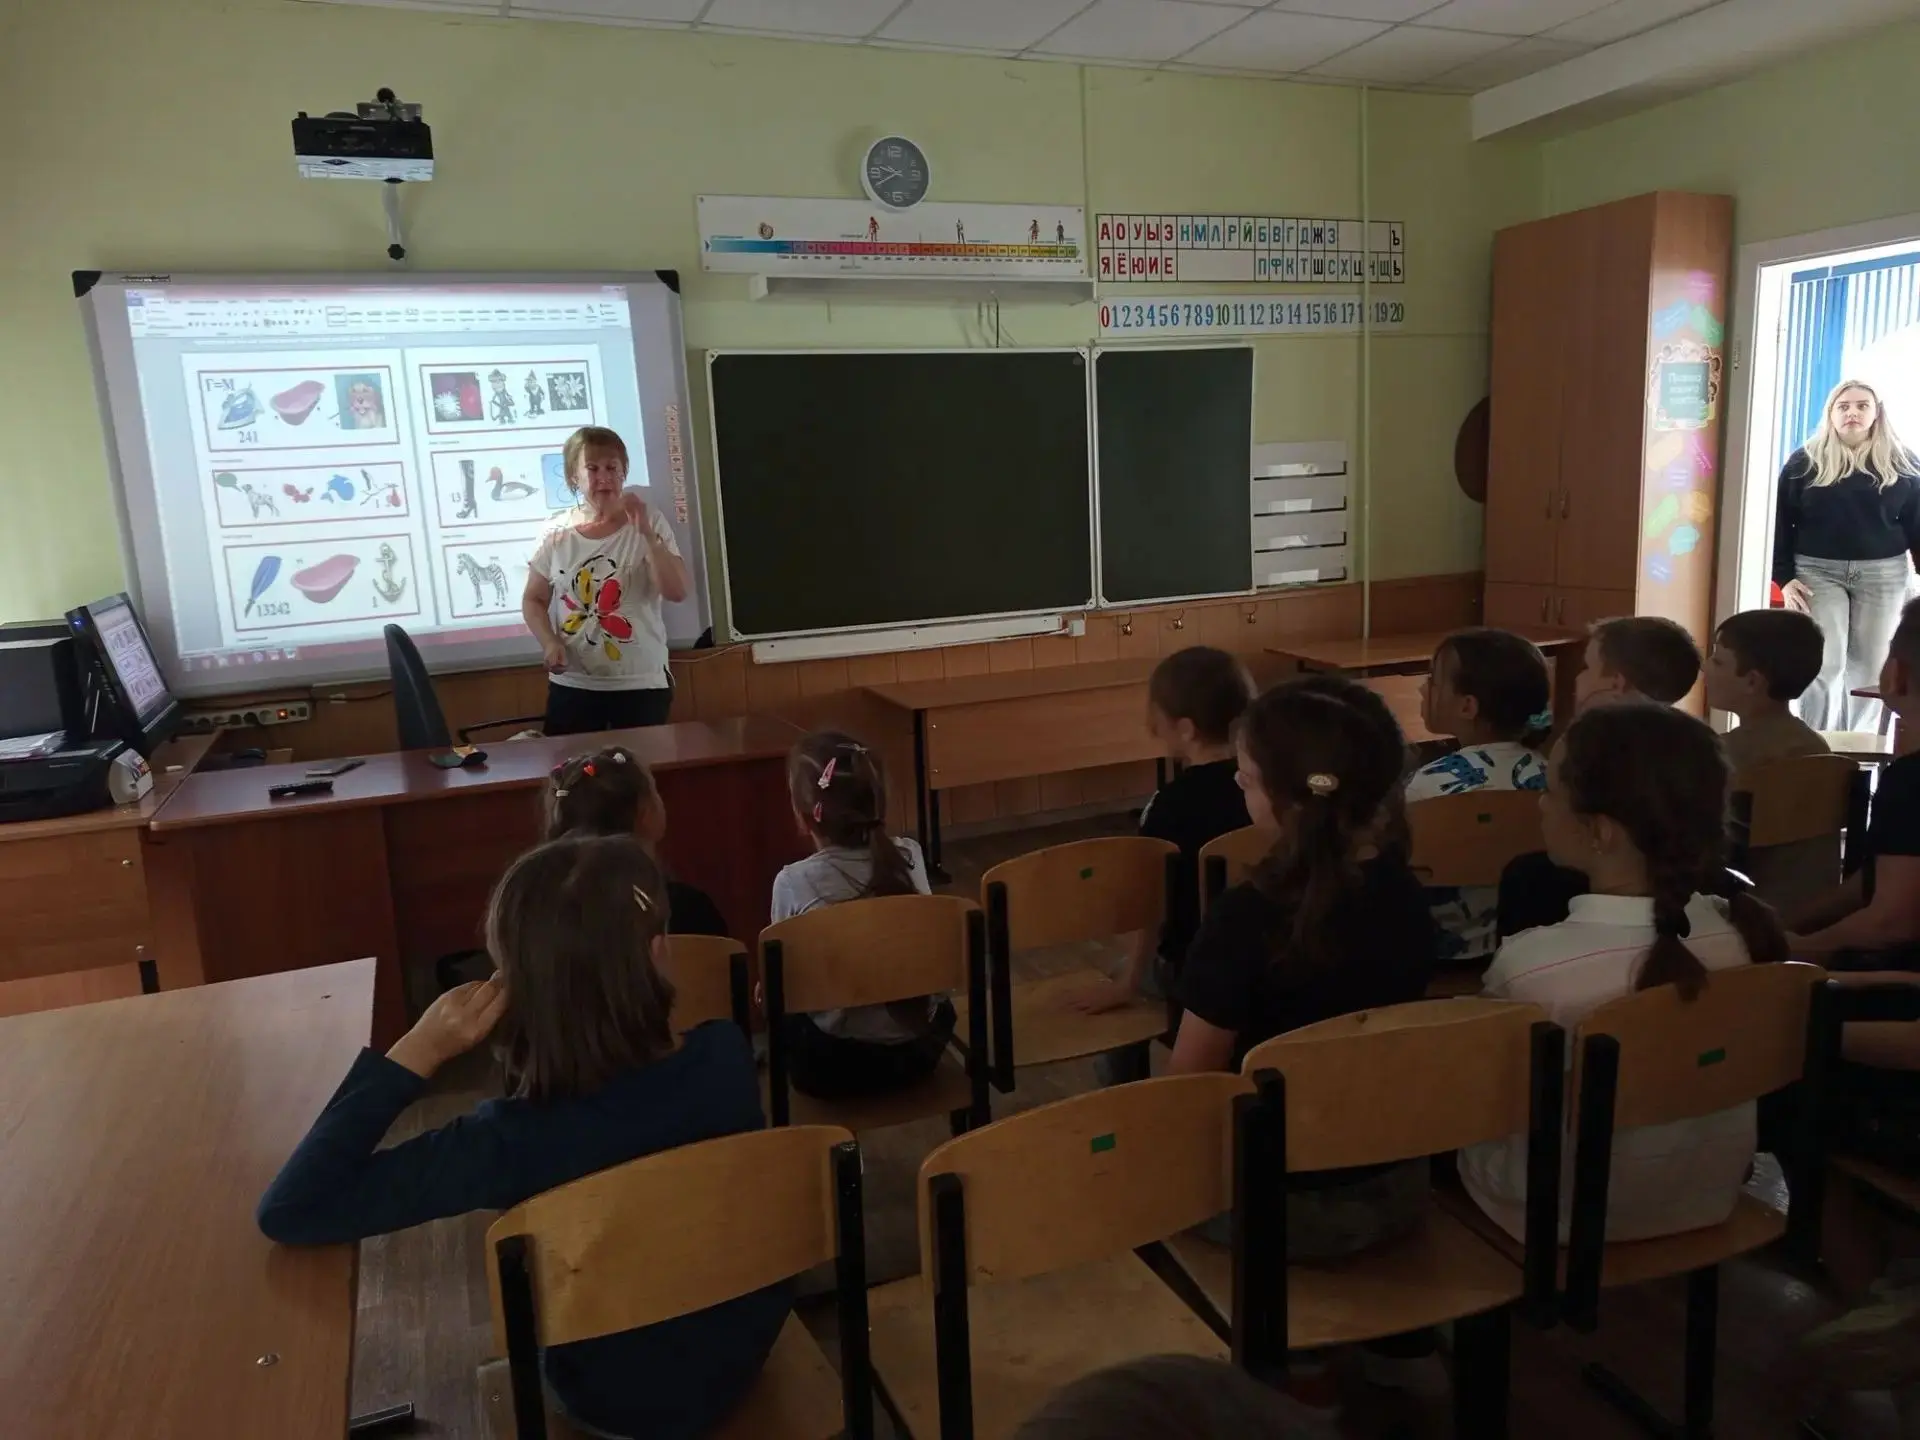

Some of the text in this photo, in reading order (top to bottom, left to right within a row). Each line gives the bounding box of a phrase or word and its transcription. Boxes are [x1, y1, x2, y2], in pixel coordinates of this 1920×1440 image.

[1101, 306, 1110, 327] 0
[1113, 305, 1119, 327] 1
[1122, 306, 1131, 327] 2
[1136, 305, 1143, 327] 3
[1147, 305, 1155, 327] 4
[1160, 304, 1168, 326] 5
[1171, 304, 1179, 326] 6
[1184, 304, 1192, 326] 7
[1195, 304, 1202, 326] 8
[1206, 304, 1214, 326] 9
[1216, 304, 1229, 325] 10
[1233, 304, 1245, 325] 11
[1250, 304, 1264, 325] 12
[1269, 303, 1283, 324] 13
[1288, 303, 1301, 324] 14
[1306, 303, 1321, 324] 15
[1324, 303, 1336, 324] 16
[1341, 303, 1354, 323] 17
[1375, 302, 1388, 322] 19
[1390, 303, 1404, 322] 20
[238, 430, 258, 443] 241
[256, 602, 291, 617] 13242
